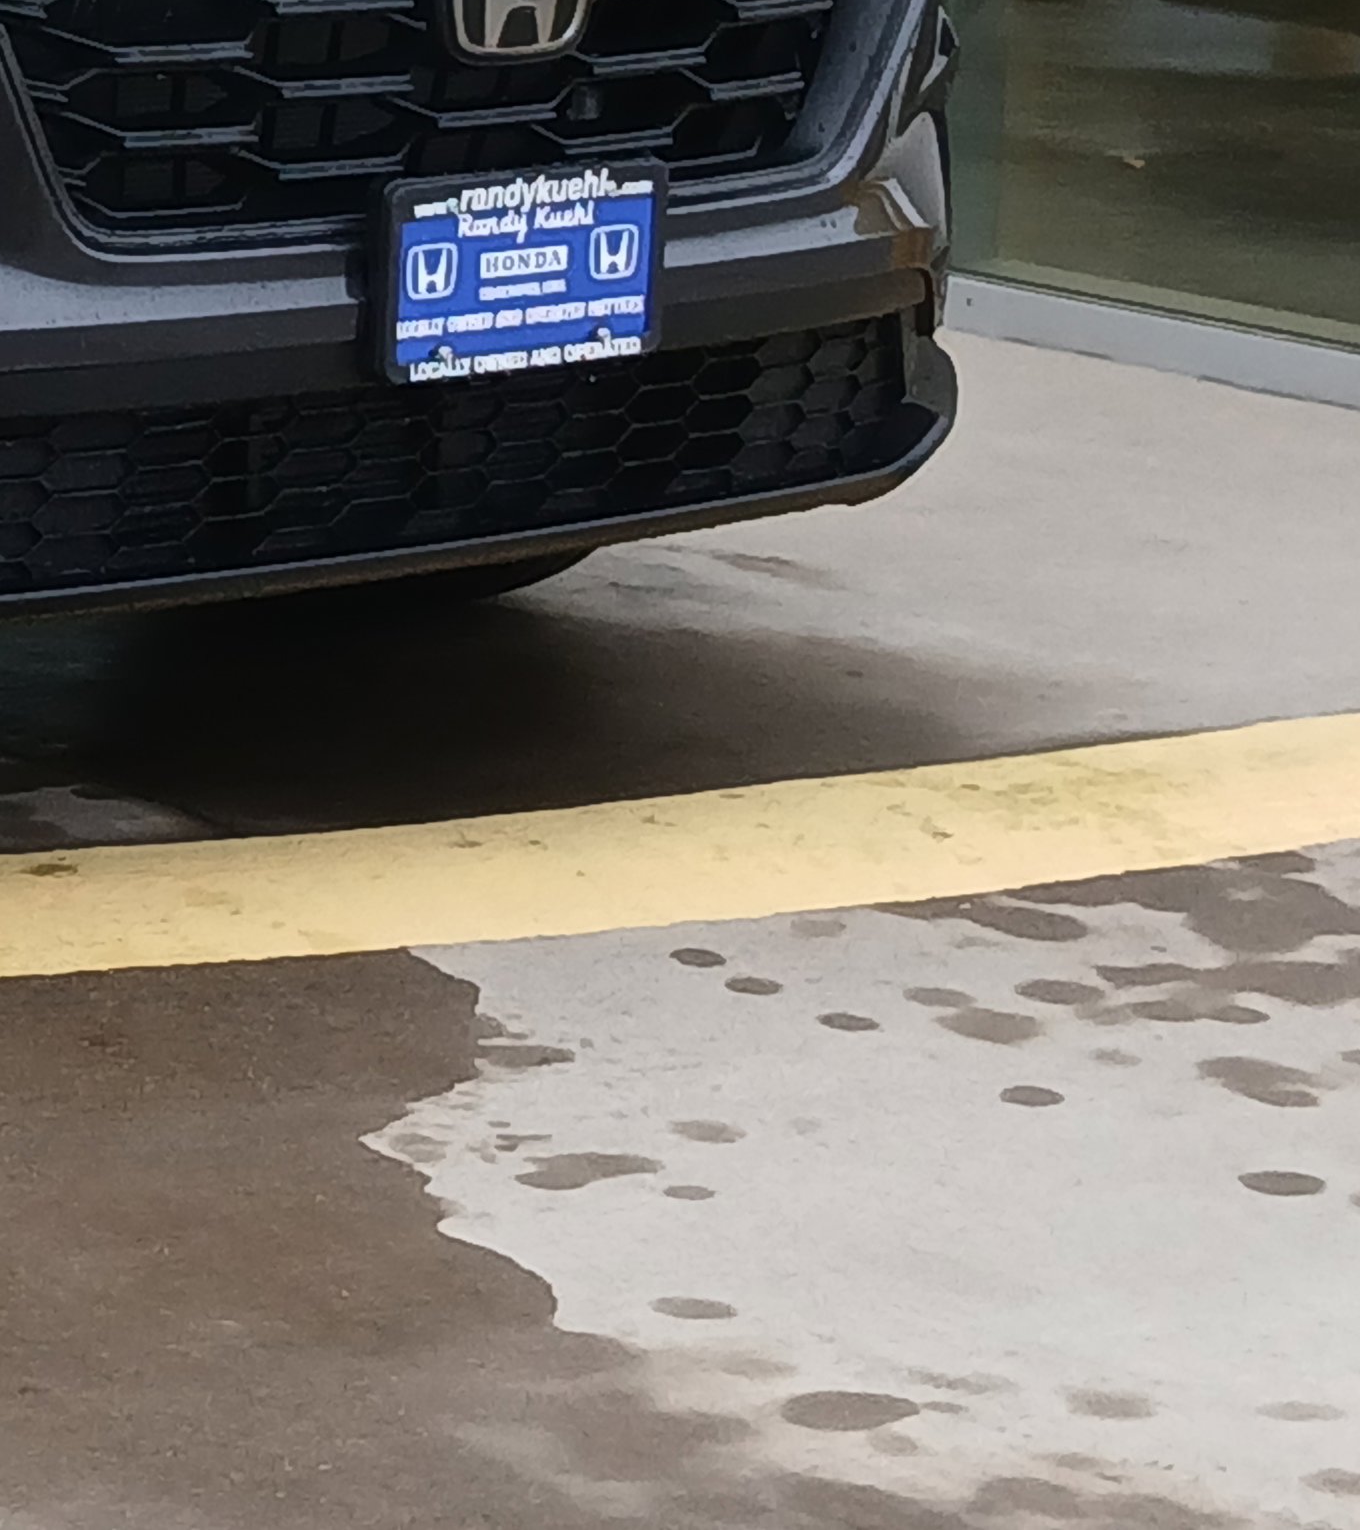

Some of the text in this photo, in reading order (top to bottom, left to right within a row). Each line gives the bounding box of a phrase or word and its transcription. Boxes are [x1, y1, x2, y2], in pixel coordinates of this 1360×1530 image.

[457, 199, 595, 244] Randy Kuehl
[485, 249, 562, 273] HONDA
